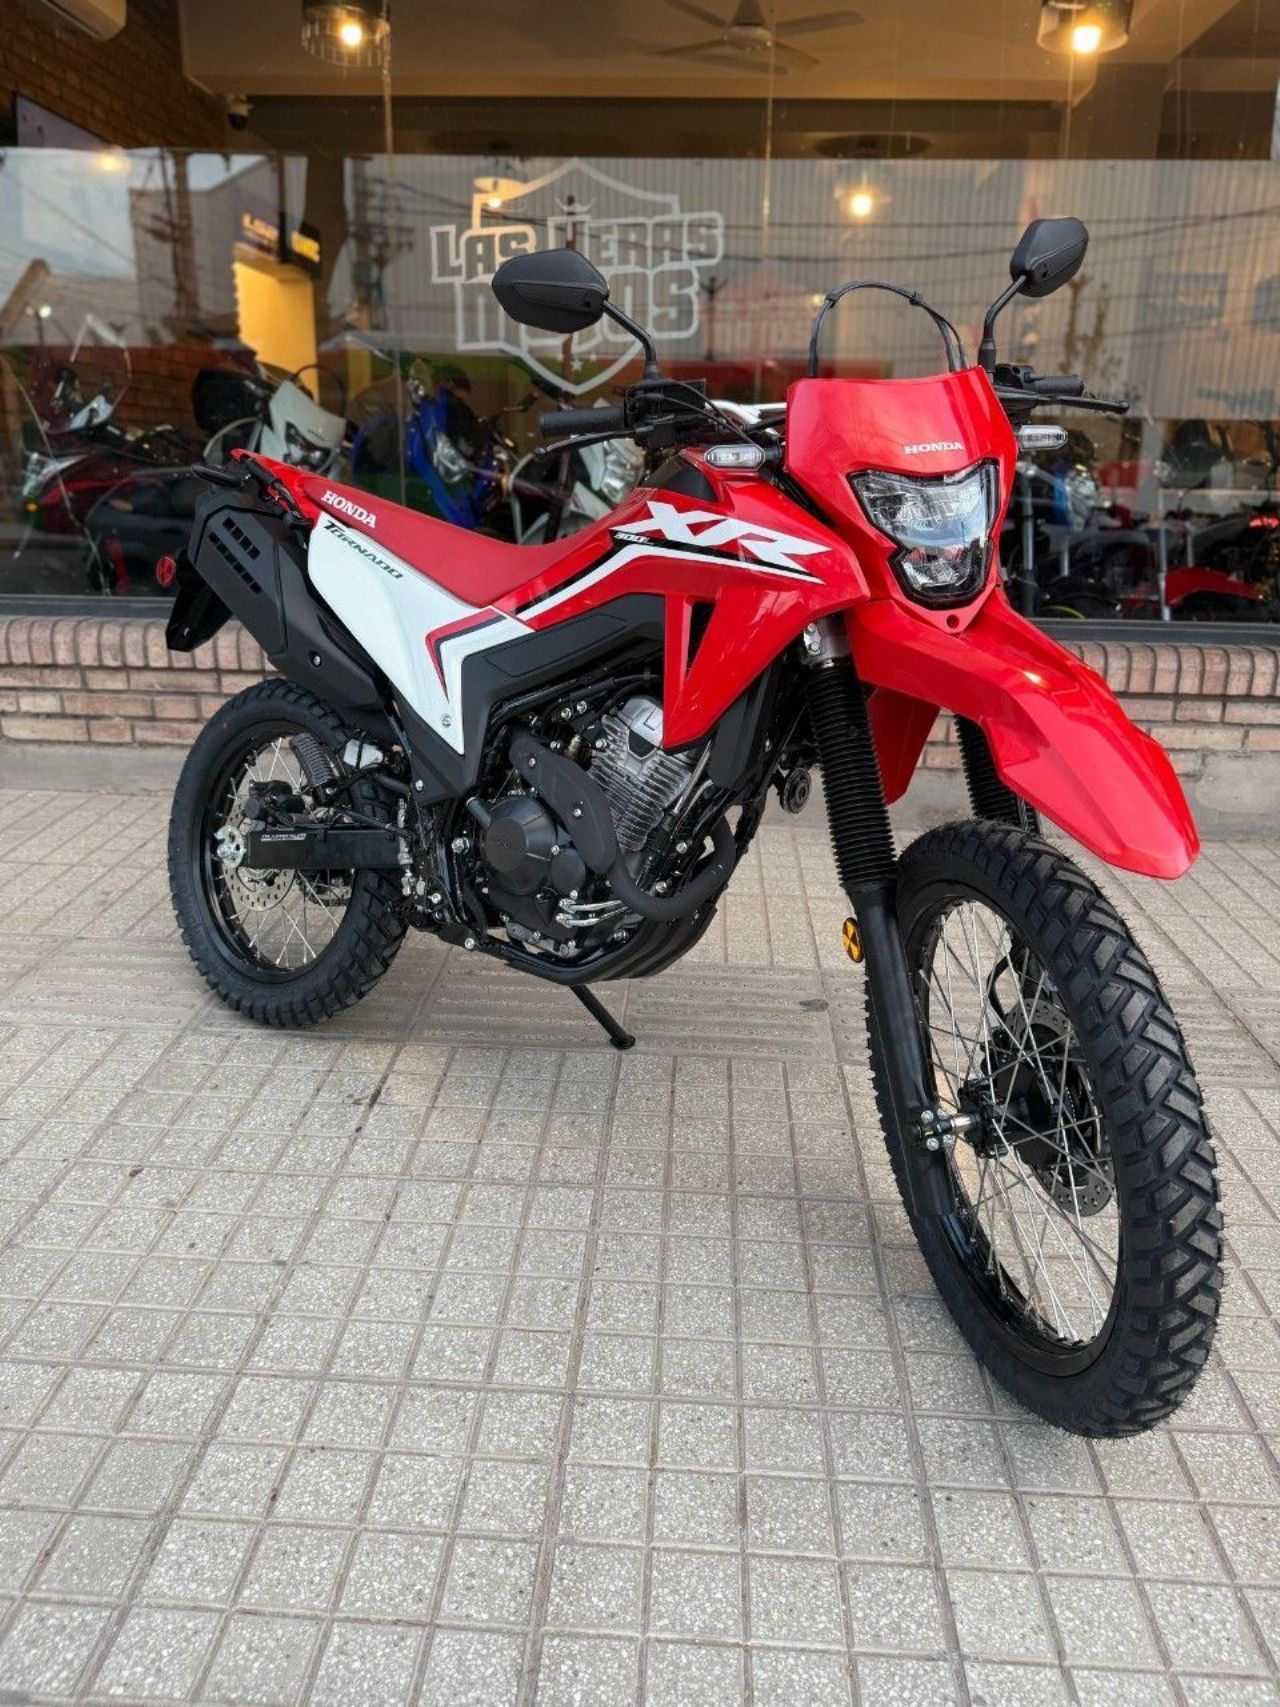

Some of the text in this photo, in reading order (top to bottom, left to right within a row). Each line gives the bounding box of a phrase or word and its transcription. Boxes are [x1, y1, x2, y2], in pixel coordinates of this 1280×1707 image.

[430, 224, 536, 284] LAS
[903, 442, 964, 454] HONDA
[321, 490, 377, 529] HONDA
[608, 500, 832, 573] XR
